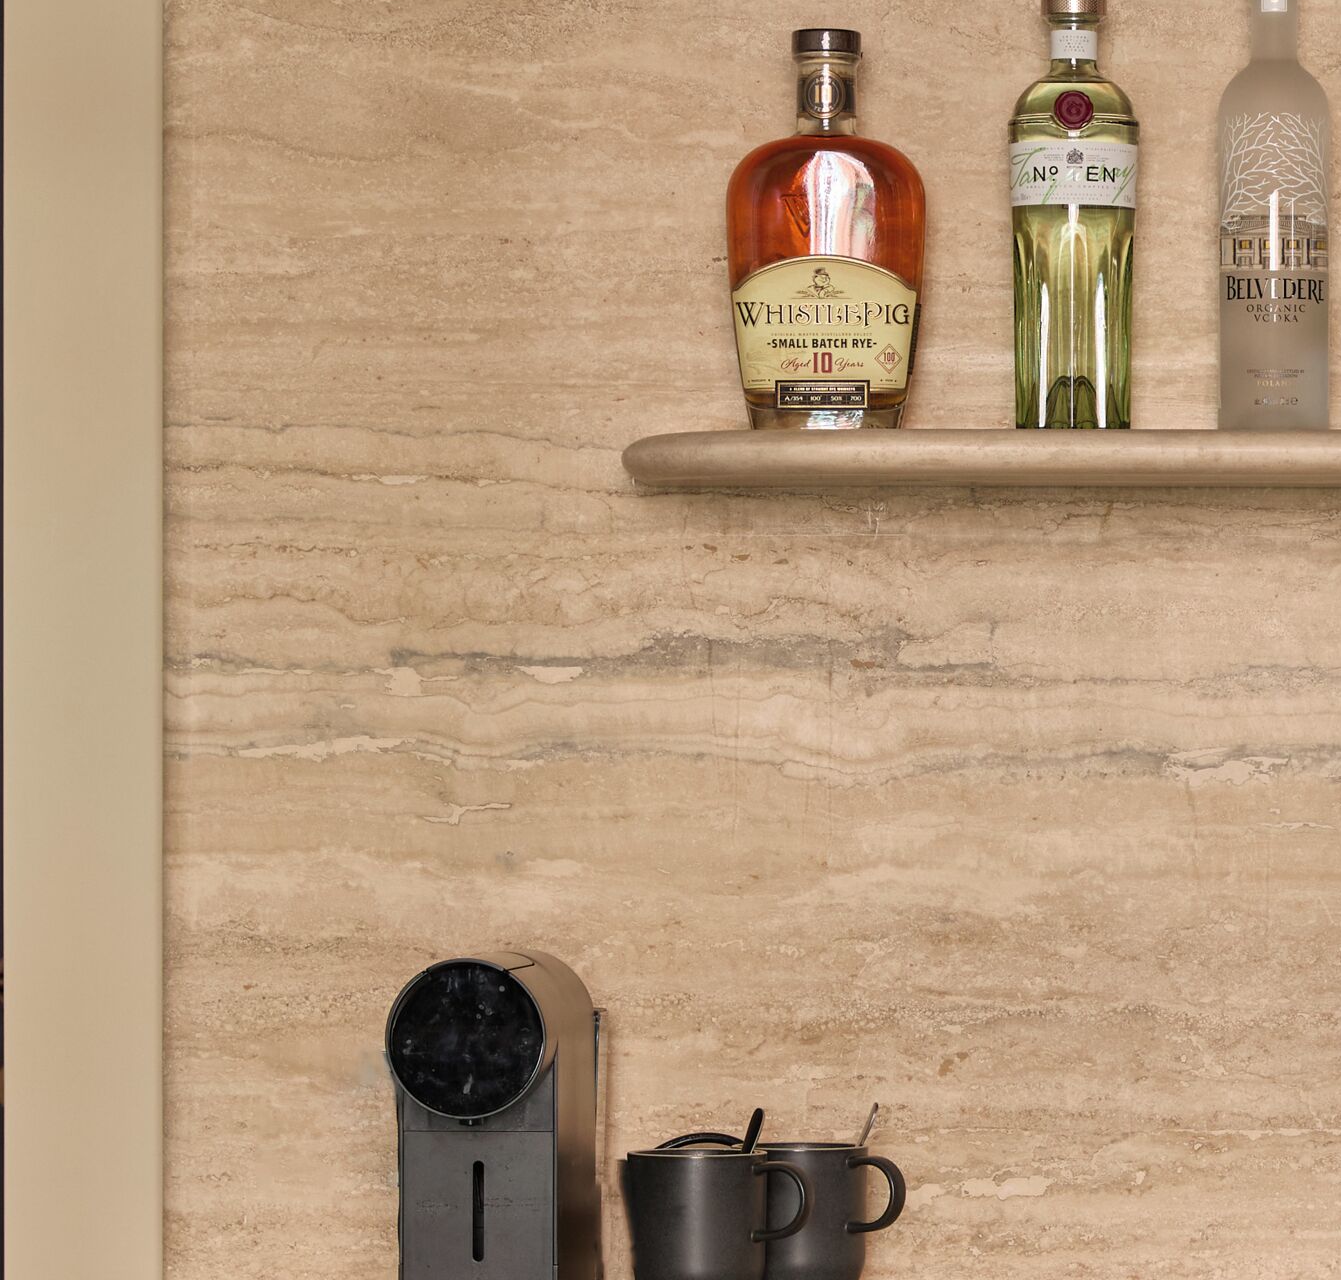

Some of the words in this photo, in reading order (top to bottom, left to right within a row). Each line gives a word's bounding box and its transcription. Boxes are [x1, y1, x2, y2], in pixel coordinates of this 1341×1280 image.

[1226, 275, 1325, 304] BELVEDERE
[1246, 304, 1306, 313] ORGANIC
[812, 338, 848, 349] BATCH
[883, 352, 896, 362] 100
[780, 357, 812, 371] Aged
[813, 352, 833, 374] 10
[834, 357, 865, 373] Years
